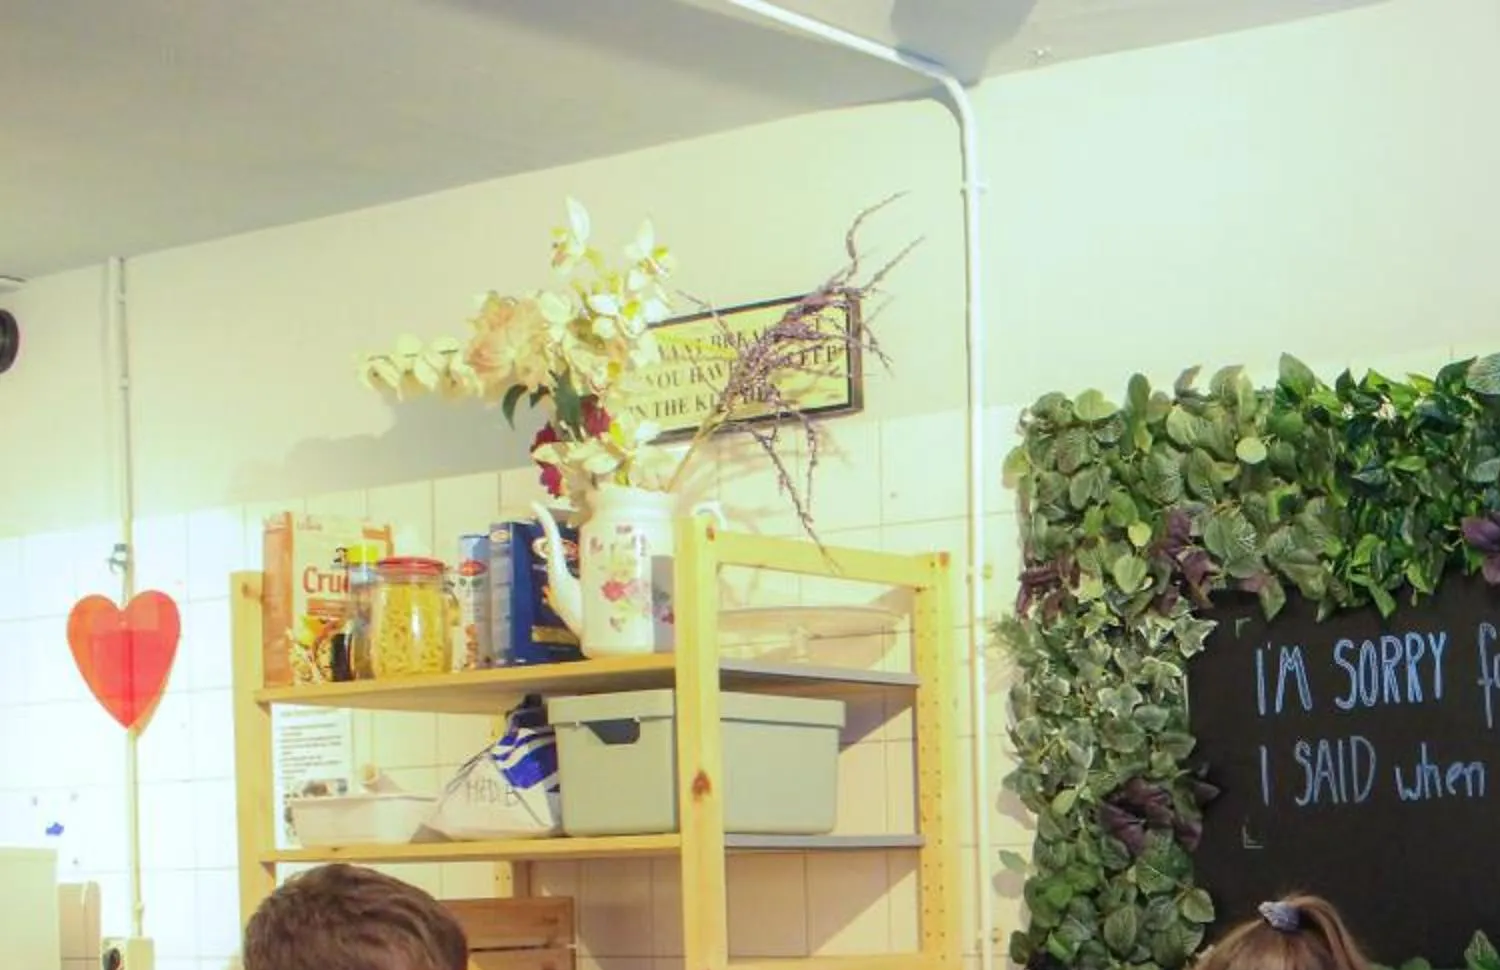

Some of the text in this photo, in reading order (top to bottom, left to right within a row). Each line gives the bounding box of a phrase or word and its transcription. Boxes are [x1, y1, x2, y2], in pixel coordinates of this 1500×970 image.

[654, 397, 690, 418] THE
[1255, 641, 1314, 715] I'M
[1333, 631, 1448, 711] SORRY
[1259, 745, 1270, 806] I
[1294, 734, 1378, 807] SAID
[1395, 742, 1487, 802] when
